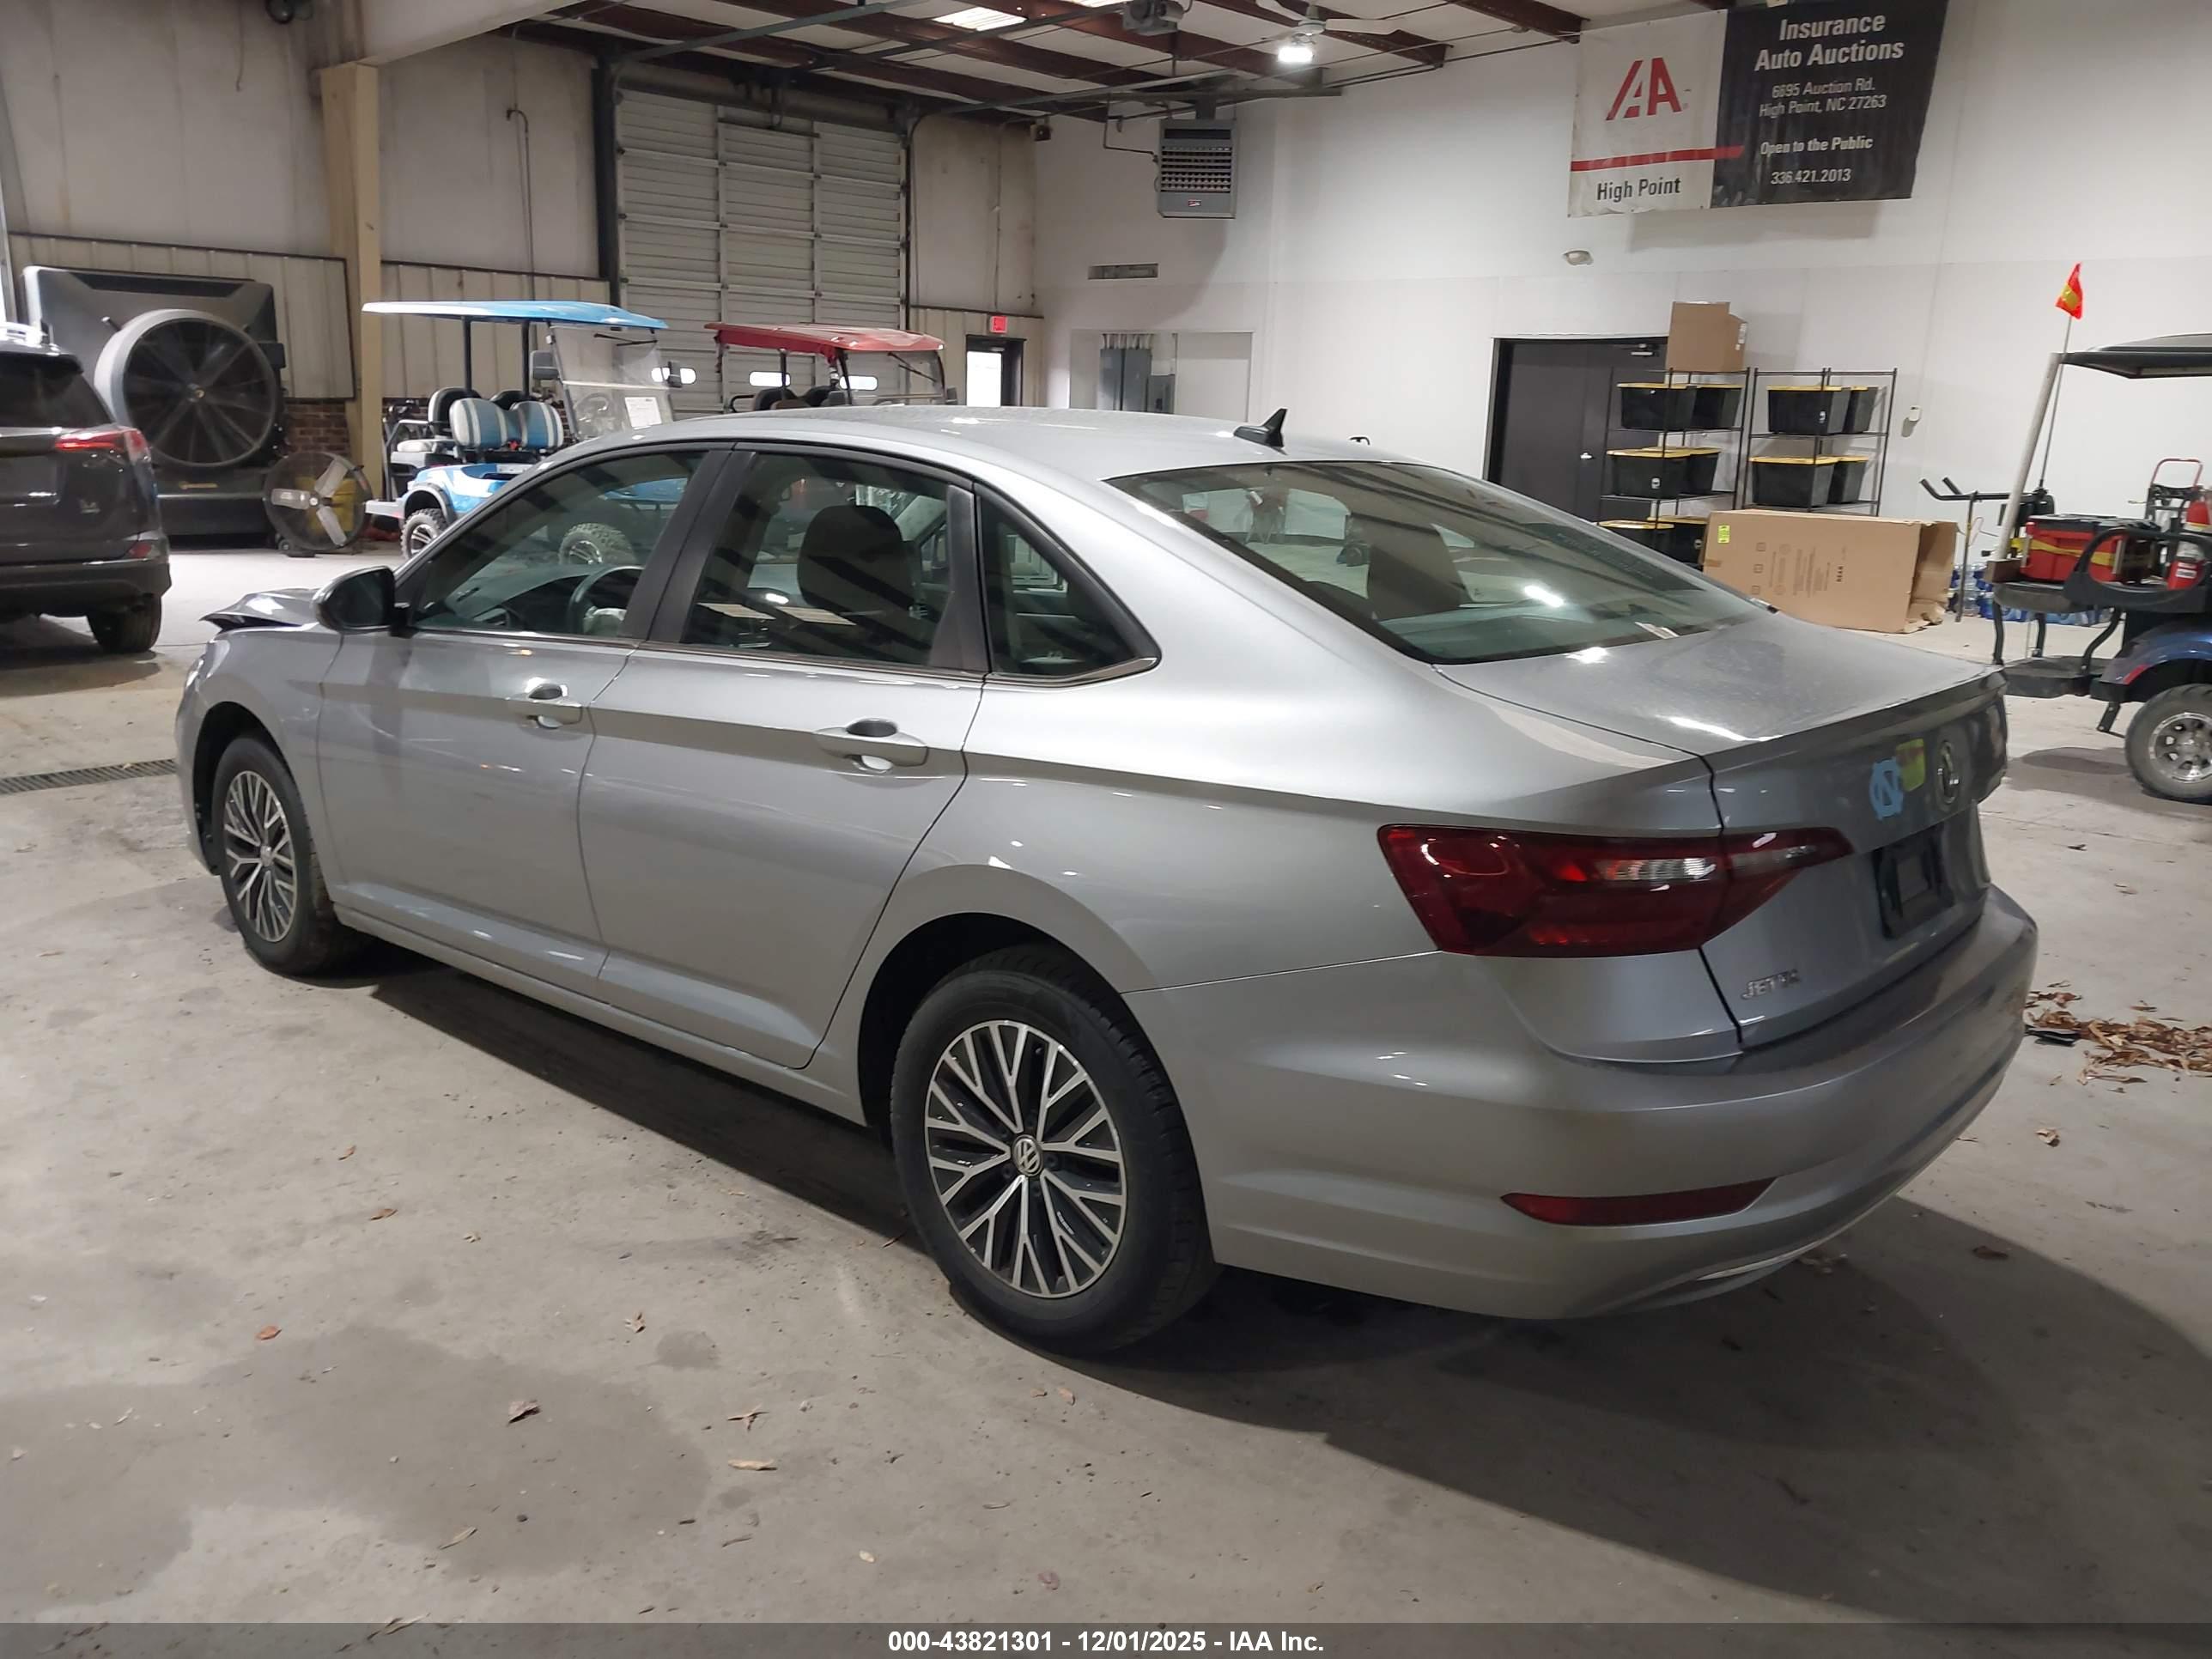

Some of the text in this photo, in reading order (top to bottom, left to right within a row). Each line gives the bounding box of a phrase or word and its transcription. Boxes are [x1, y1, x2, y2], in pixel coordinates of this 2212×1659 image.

[1779, 15, 1886, 40] Insurance
[1754, 40, 1905, 71] Auto Auctions
[1803, 81, 1852, 95] Auction
[1855, 77, 1875, 91] Rd.
[1759, 94, 1887, 118] High Point, NC 27263
[1760, 136, 1874, 157] Open to the Public
[1771, 168, 1851, 185] 336.421.2013
[1596, 177, 1682, 203] High Point
